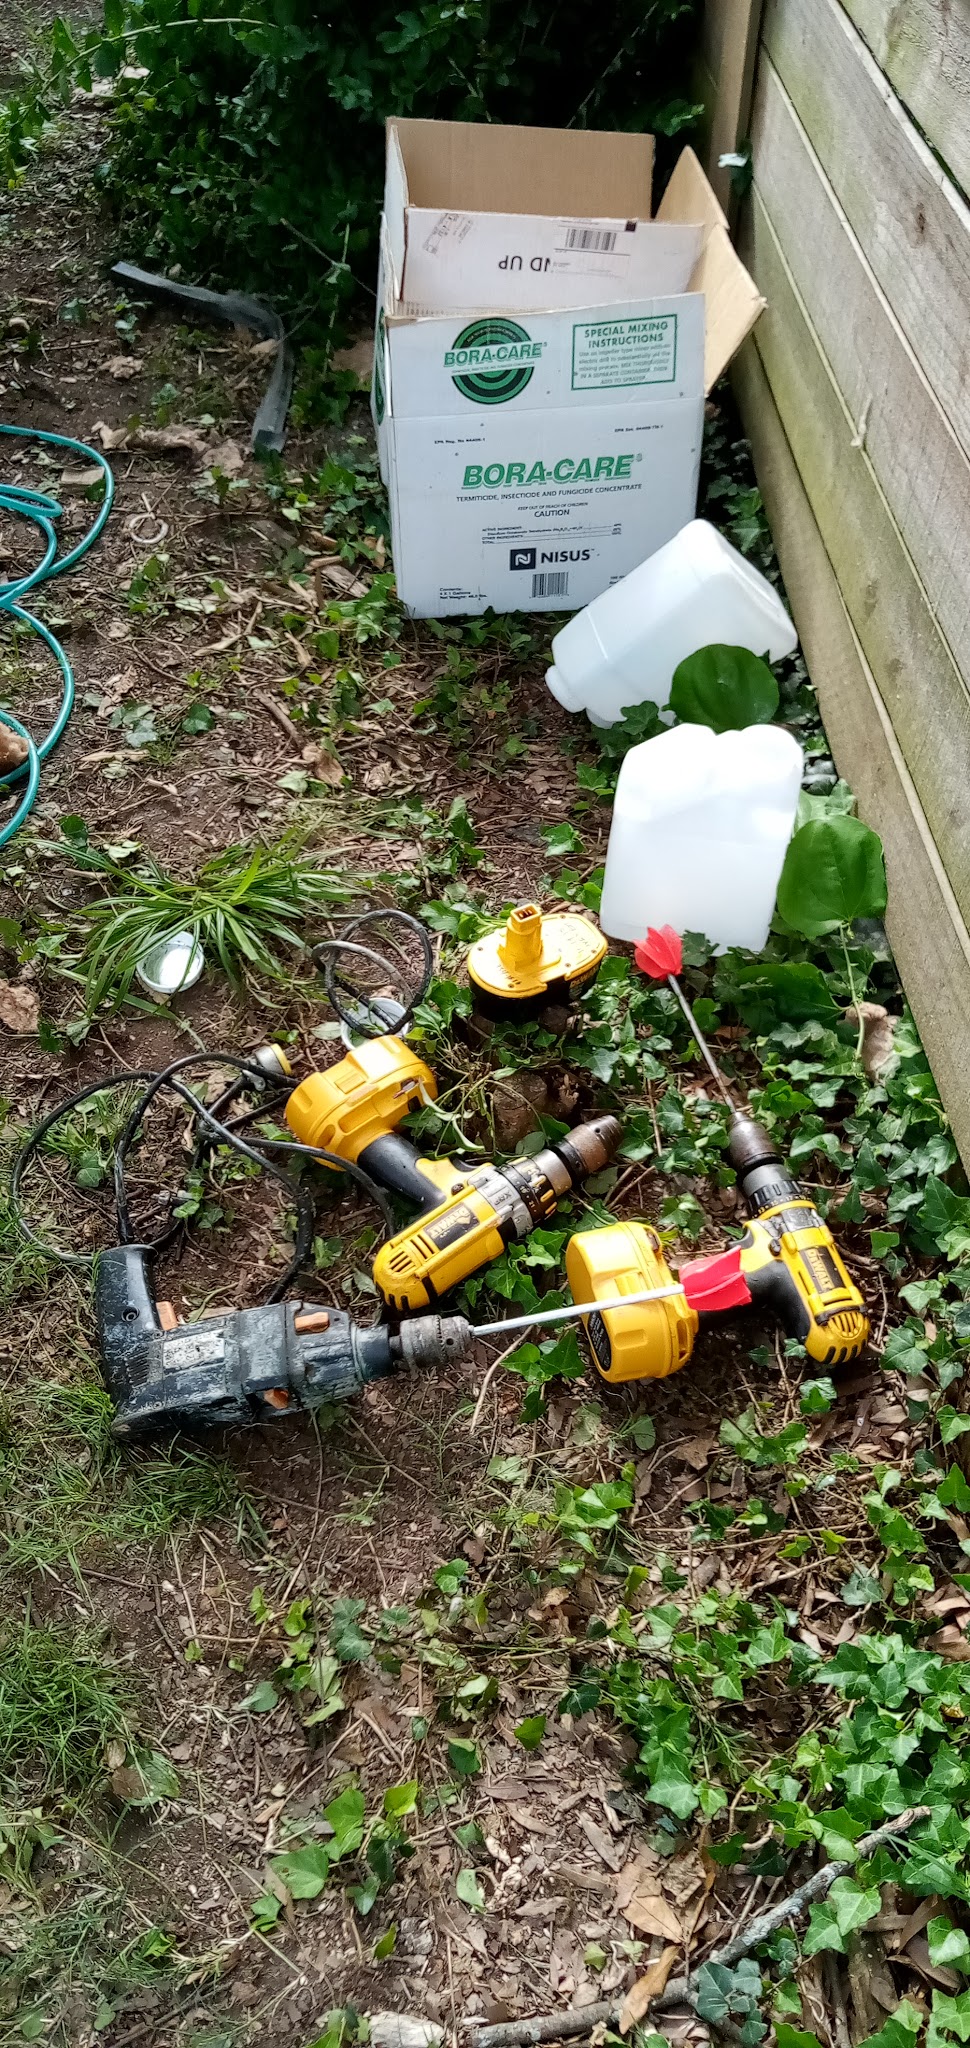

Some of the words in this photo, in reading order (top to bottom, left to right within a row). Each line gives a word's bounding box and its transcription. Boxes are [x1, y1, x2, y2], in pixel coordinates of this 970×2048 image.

[498, 254, 522, 270] UP
[584, 325, 625, 338] SPECIAL
[627, 321, 669, 333] MIXING
[588, 333, 664, 348] INSTRUCTIONS
[501, 491, 541, 500] INSECTICIDE
[558, 488, 594, 496] FUNGICIDE
[594, 483, 643, 493] CONCENTRATE
[534, 509, 570, 518] CAUTION
[541, 549, 590, 563] NISUS
